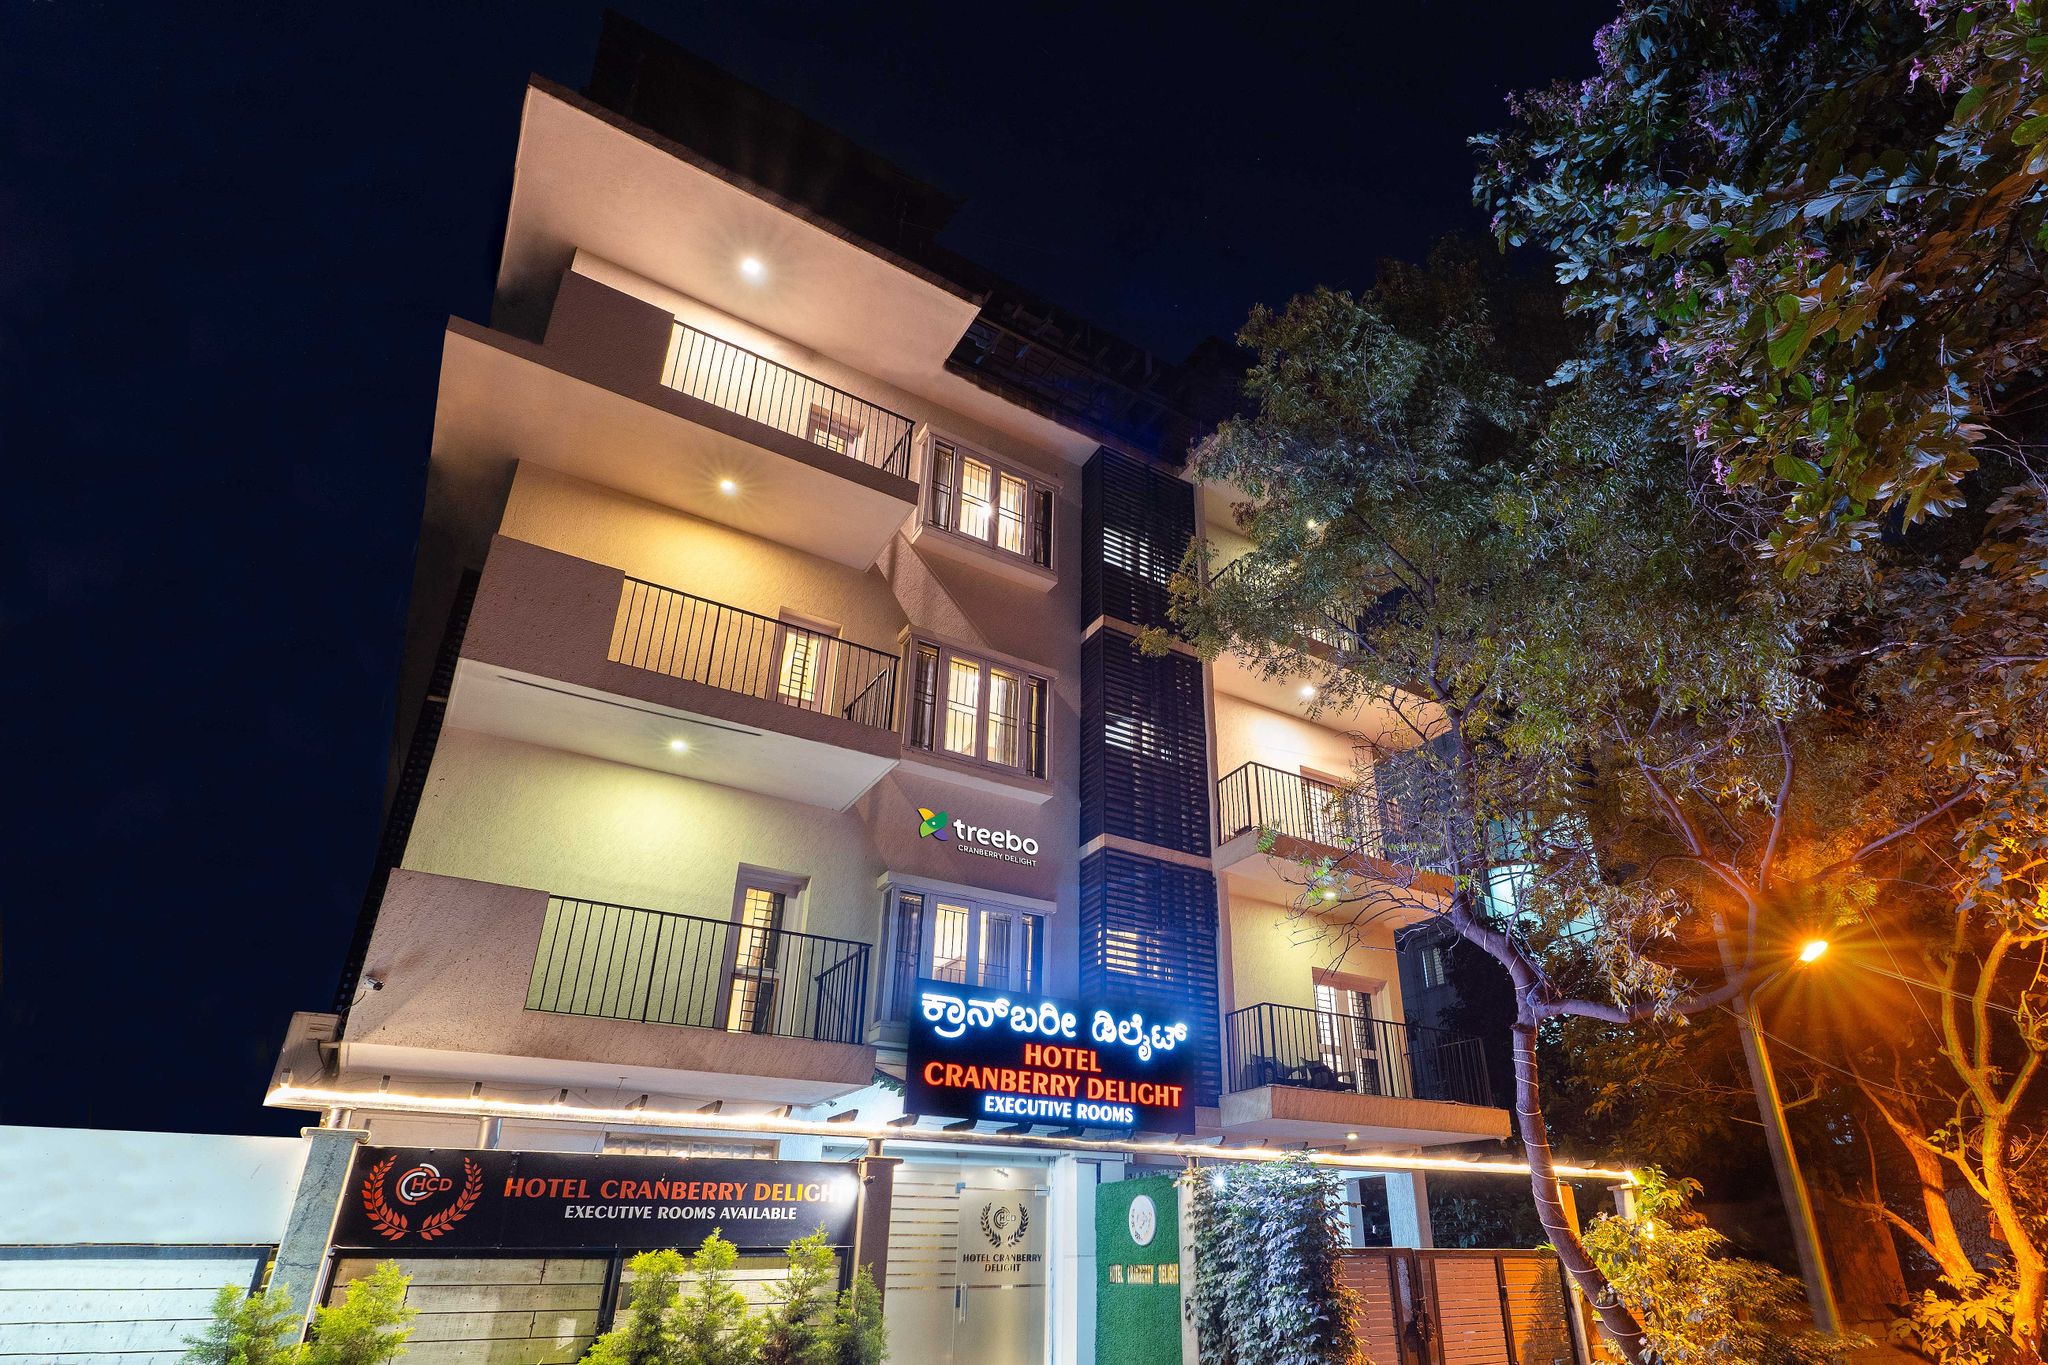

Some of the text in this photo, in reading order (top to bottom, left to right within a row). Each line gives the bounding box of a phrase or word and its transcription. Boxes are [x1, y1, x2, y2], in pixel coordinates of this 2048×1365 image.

[953, 818, 1039, 855] treebo
[958, 844, 1037, 867] CRANBERRY DELIGHT
[1024, 1043, 1102, 1073] HOTEL
[923, 1061, 1183, 1108] CRANBERRY DELIGHT
[984, 1095, 1134, 1123] EXECUTIVE ROOMS
[411, 1177, 453, 1191] HCD
[503, 1177, 852, 1202] HOTEL CRANBERRY DELIGH
[564, 1205, 798, 1220] EXECUTIVE ROOMS AVAILABLE
[962, 1253, 1042, 1262] HOTEL CRANBERRY
[984, 1263, 1021, 1272] DELIGHT
